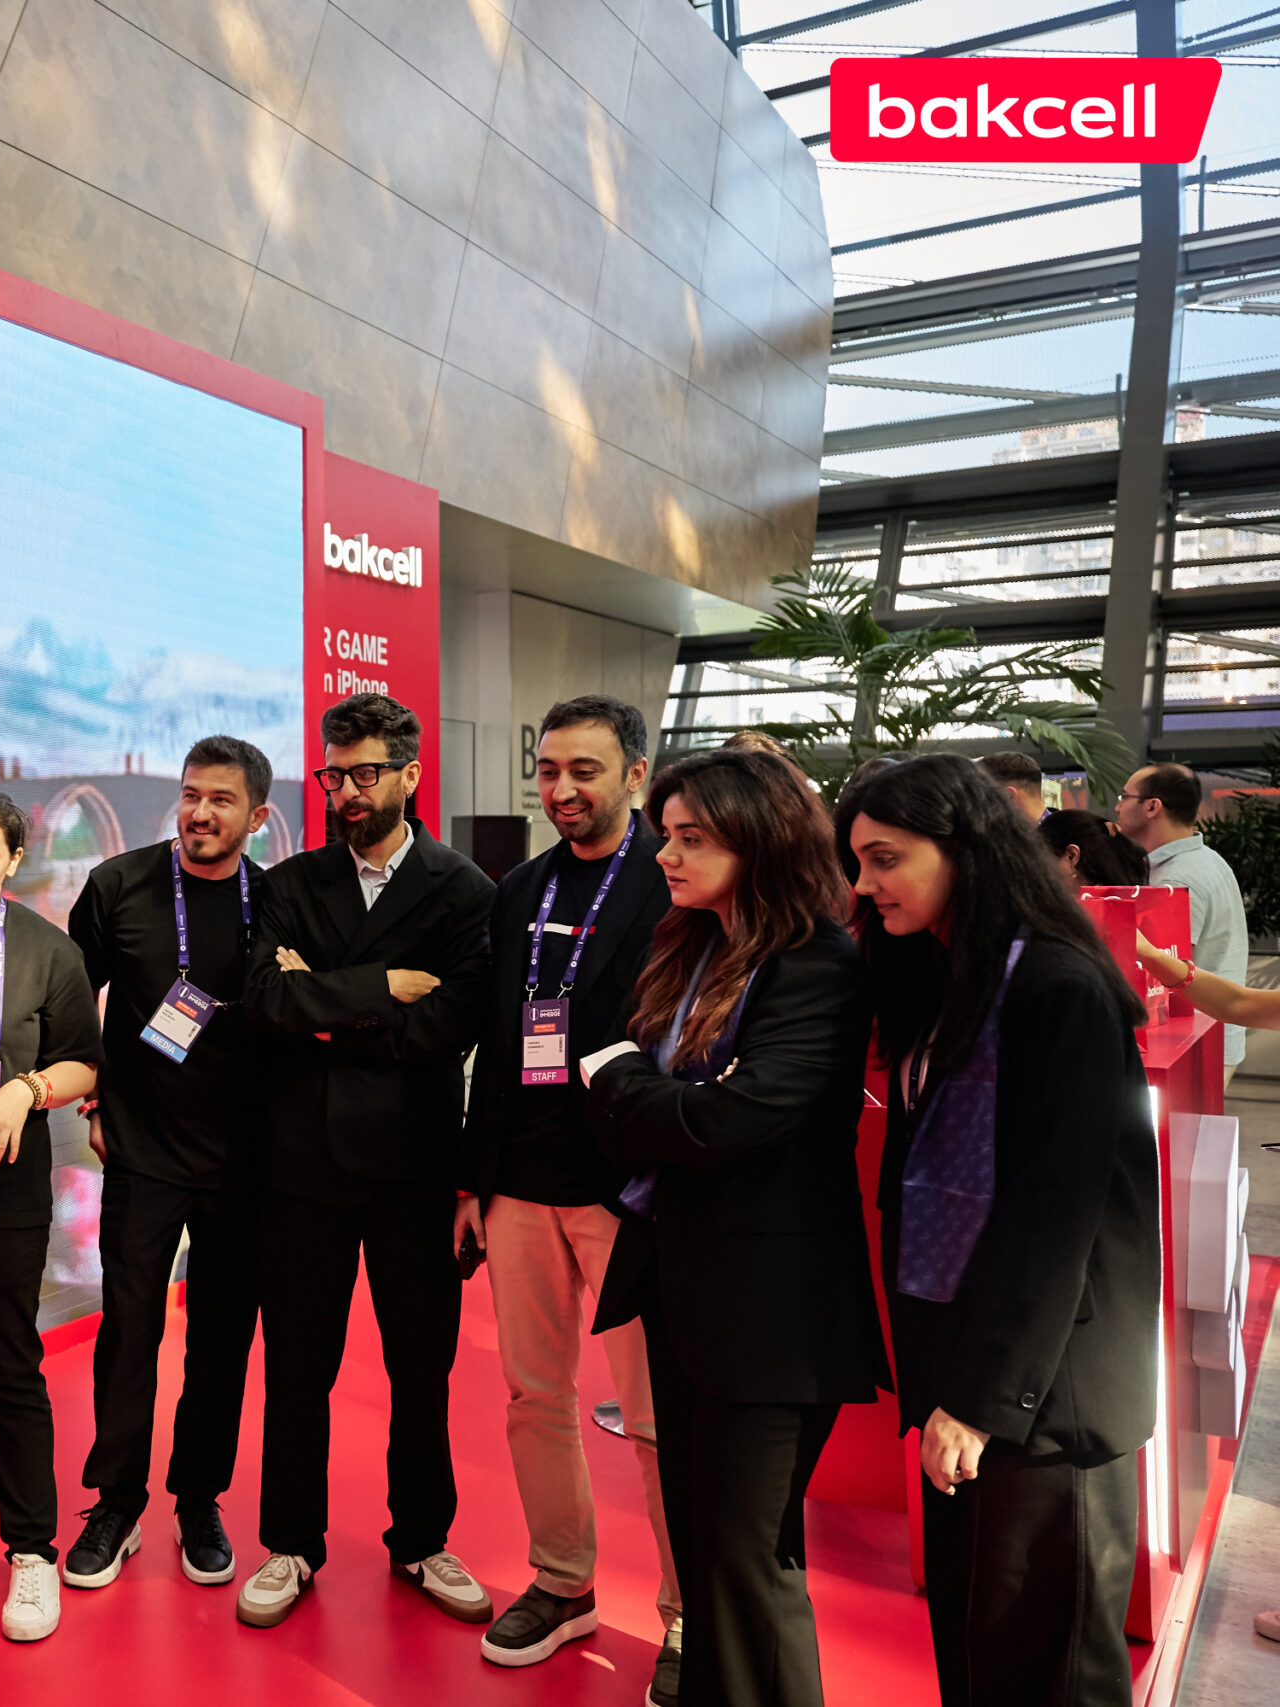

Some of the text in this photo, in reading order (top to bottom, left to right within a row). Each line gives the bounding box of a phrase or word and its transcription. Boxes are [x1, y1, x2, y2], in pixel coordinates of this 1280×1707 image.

[323, 522, 422, 588] bakcell
[337, 628, 388, 666] GAME
[337, 667, 388, 698] iPhone
[521, 724, 538, 780] B
[150, 1033, 176, 1055] MEDIA
[532, 1071, 557, 1082] STAFF
